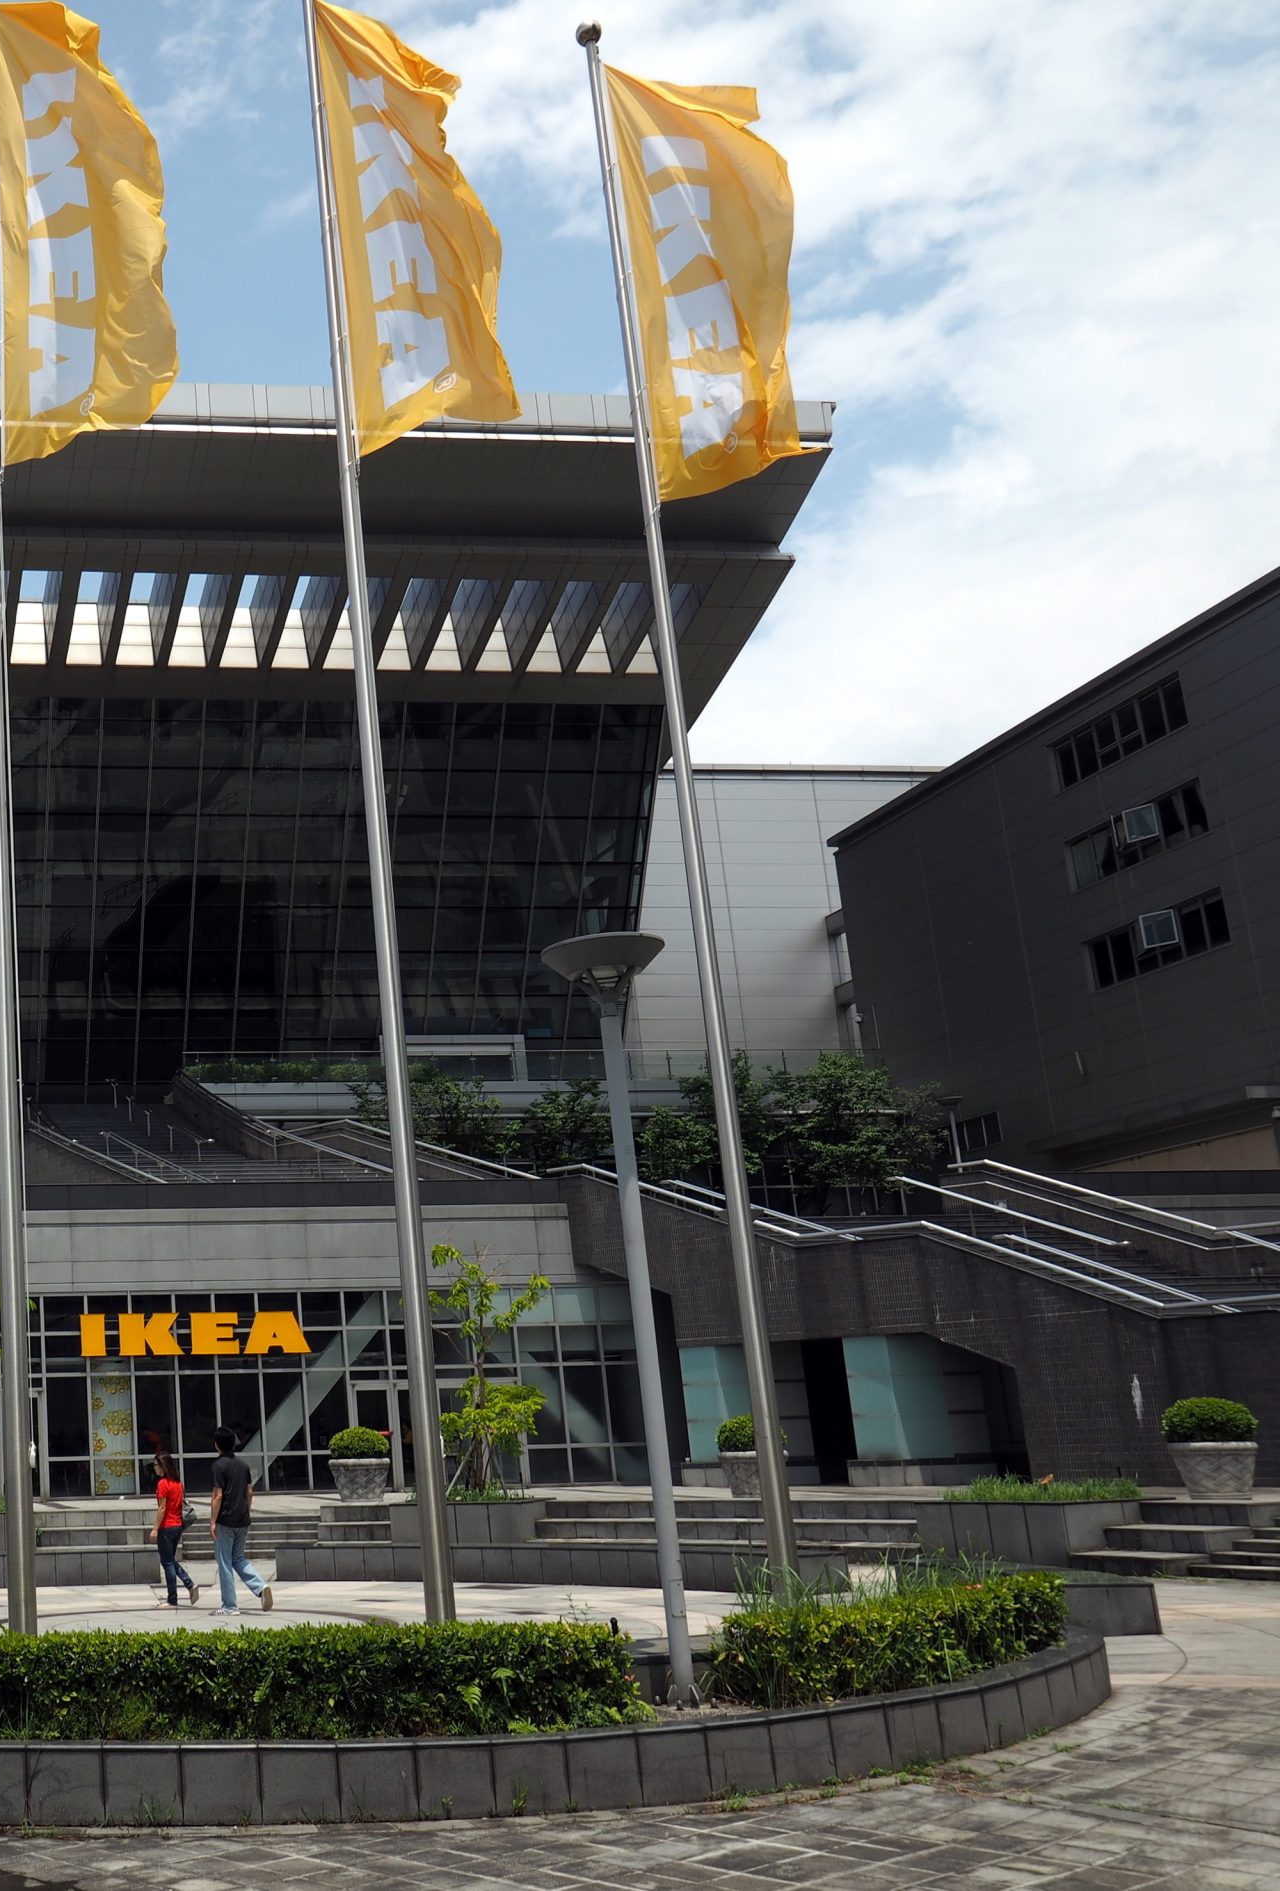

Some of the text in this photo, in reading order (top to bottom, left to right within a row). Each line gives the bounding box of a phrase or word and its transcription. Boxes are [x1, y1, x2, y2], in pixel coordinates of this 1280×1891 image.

[22, 68, 96, 418] IKEA
[347, 71, 450, 412] IKEA
[641, 135, 743, 460] IKEA
[80, 1311, 312, 1357] IKEA
